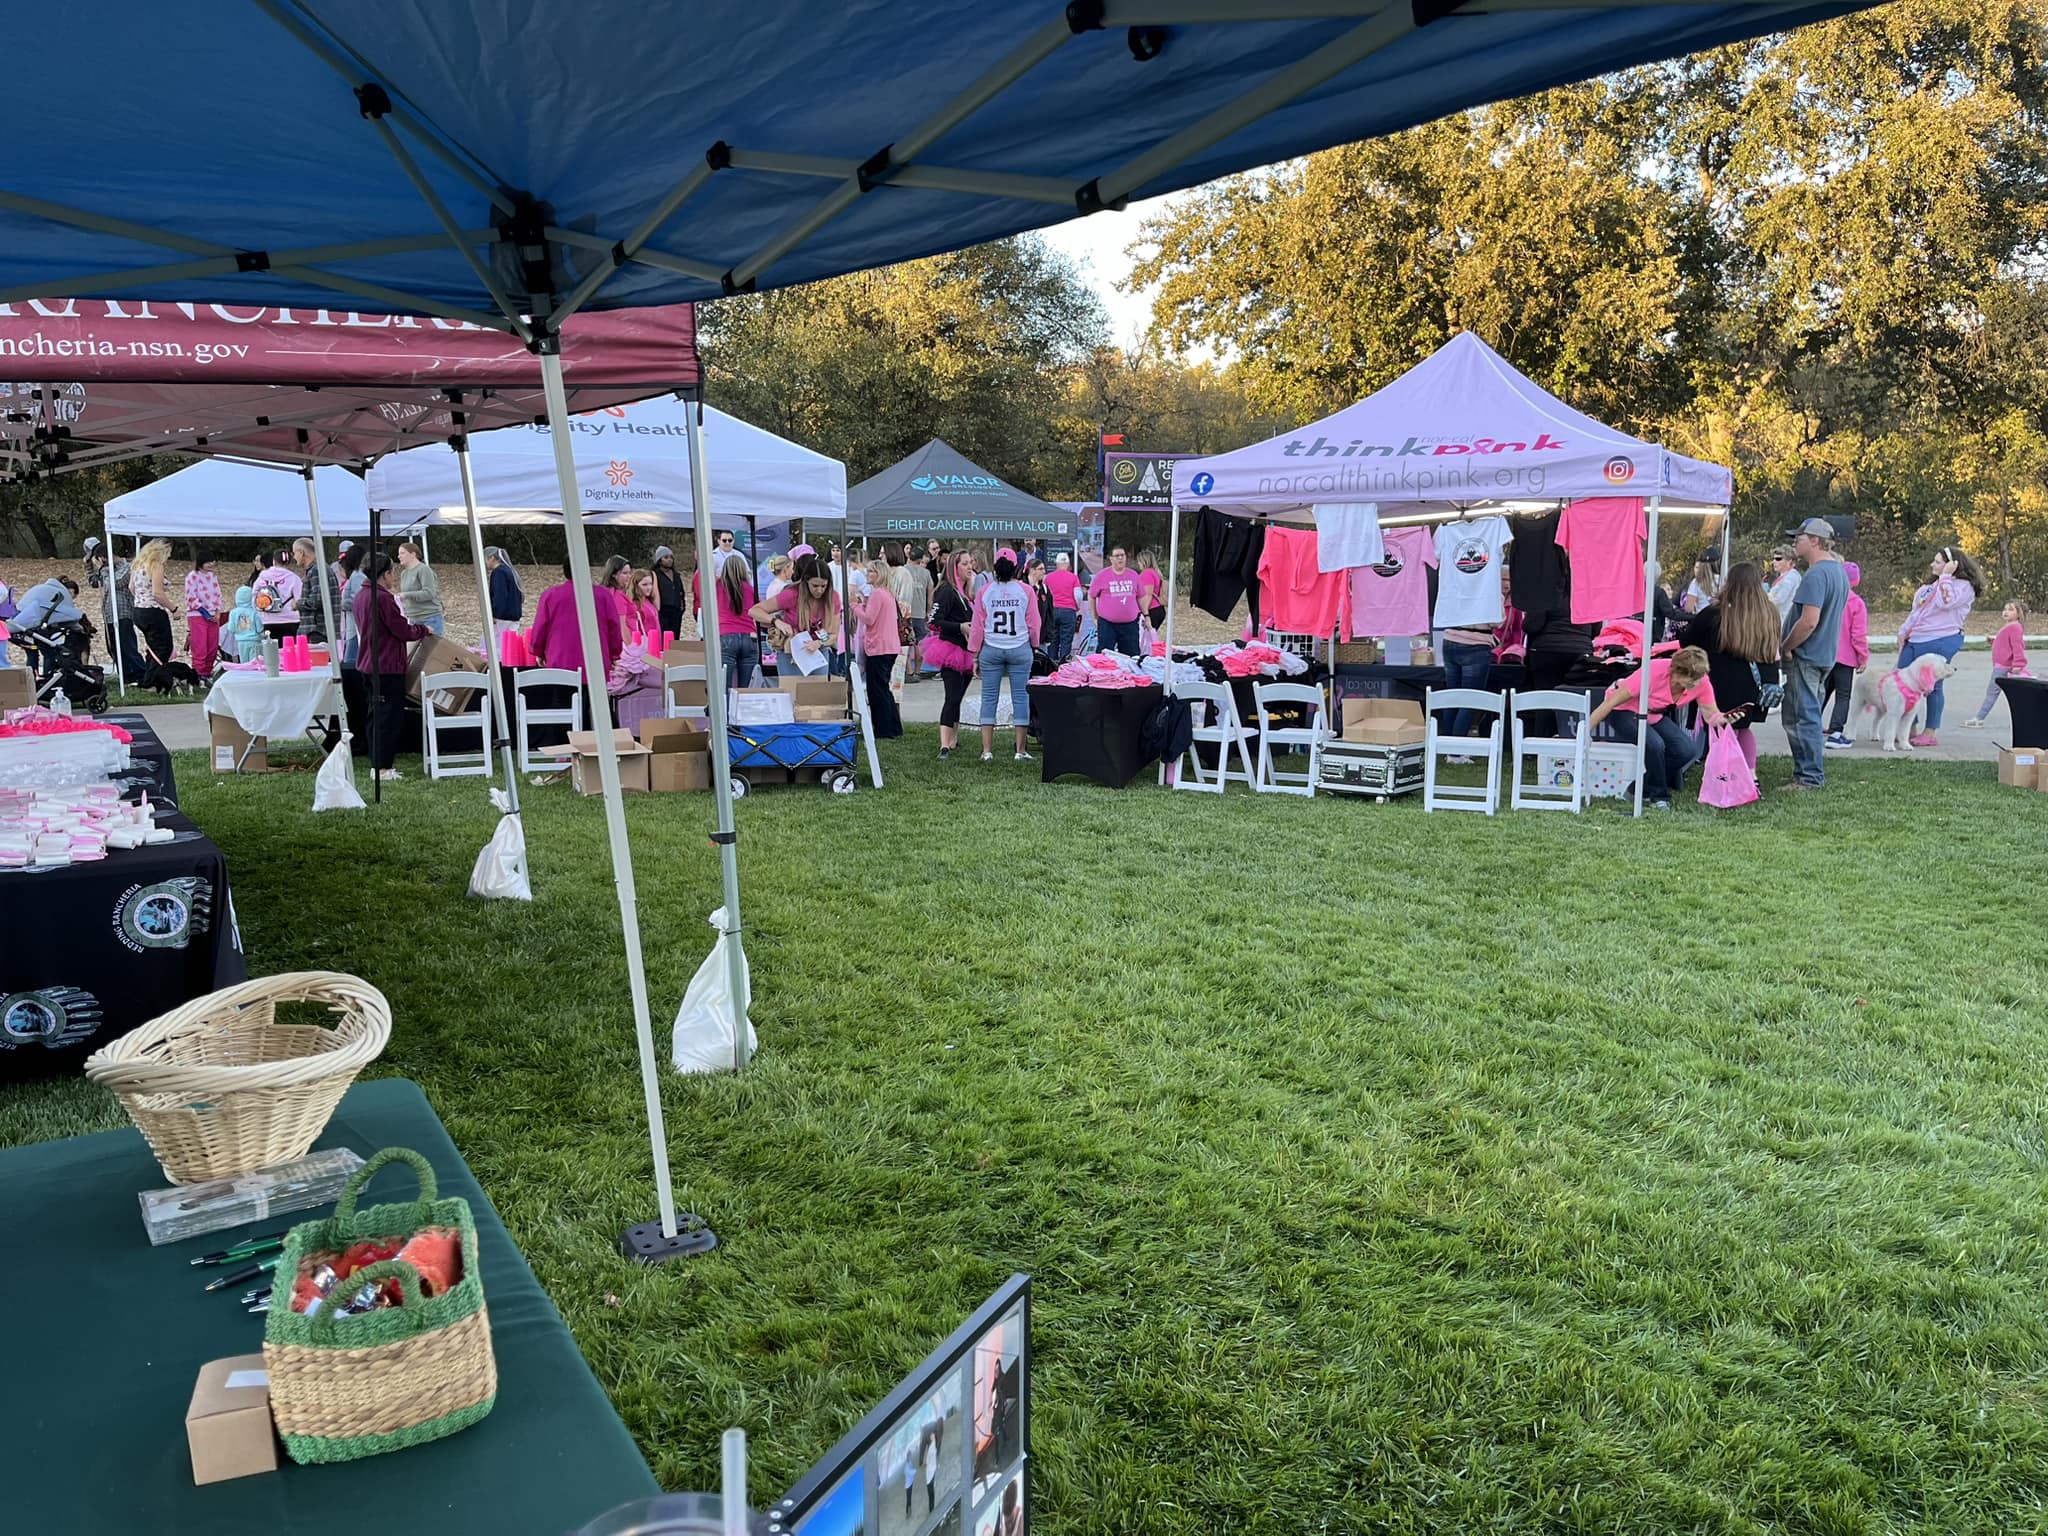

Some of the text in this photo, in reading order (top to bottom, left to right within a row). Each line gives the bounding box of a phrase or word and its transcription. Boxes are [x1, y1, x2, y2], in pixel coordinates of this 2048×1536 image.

[614, 421, 689, 437] Healt
[936, 474, 1001, 487] VALOR
[1257, 458, 1547, 498] norcalthinkpink.org
[584, 488, 621, 501] Dignity
[1111, 495, 1130, 504] Nov
[1131, 495, 1144, 504] 22
[1150, 495, 1169, 504] Jan
[886, 519, 1056, 533] FIGHT CANCER WITH VALOR
[992, 610, 1017, 636] 21
[111, 882, 145, 953] REDDING RANCHERIA
